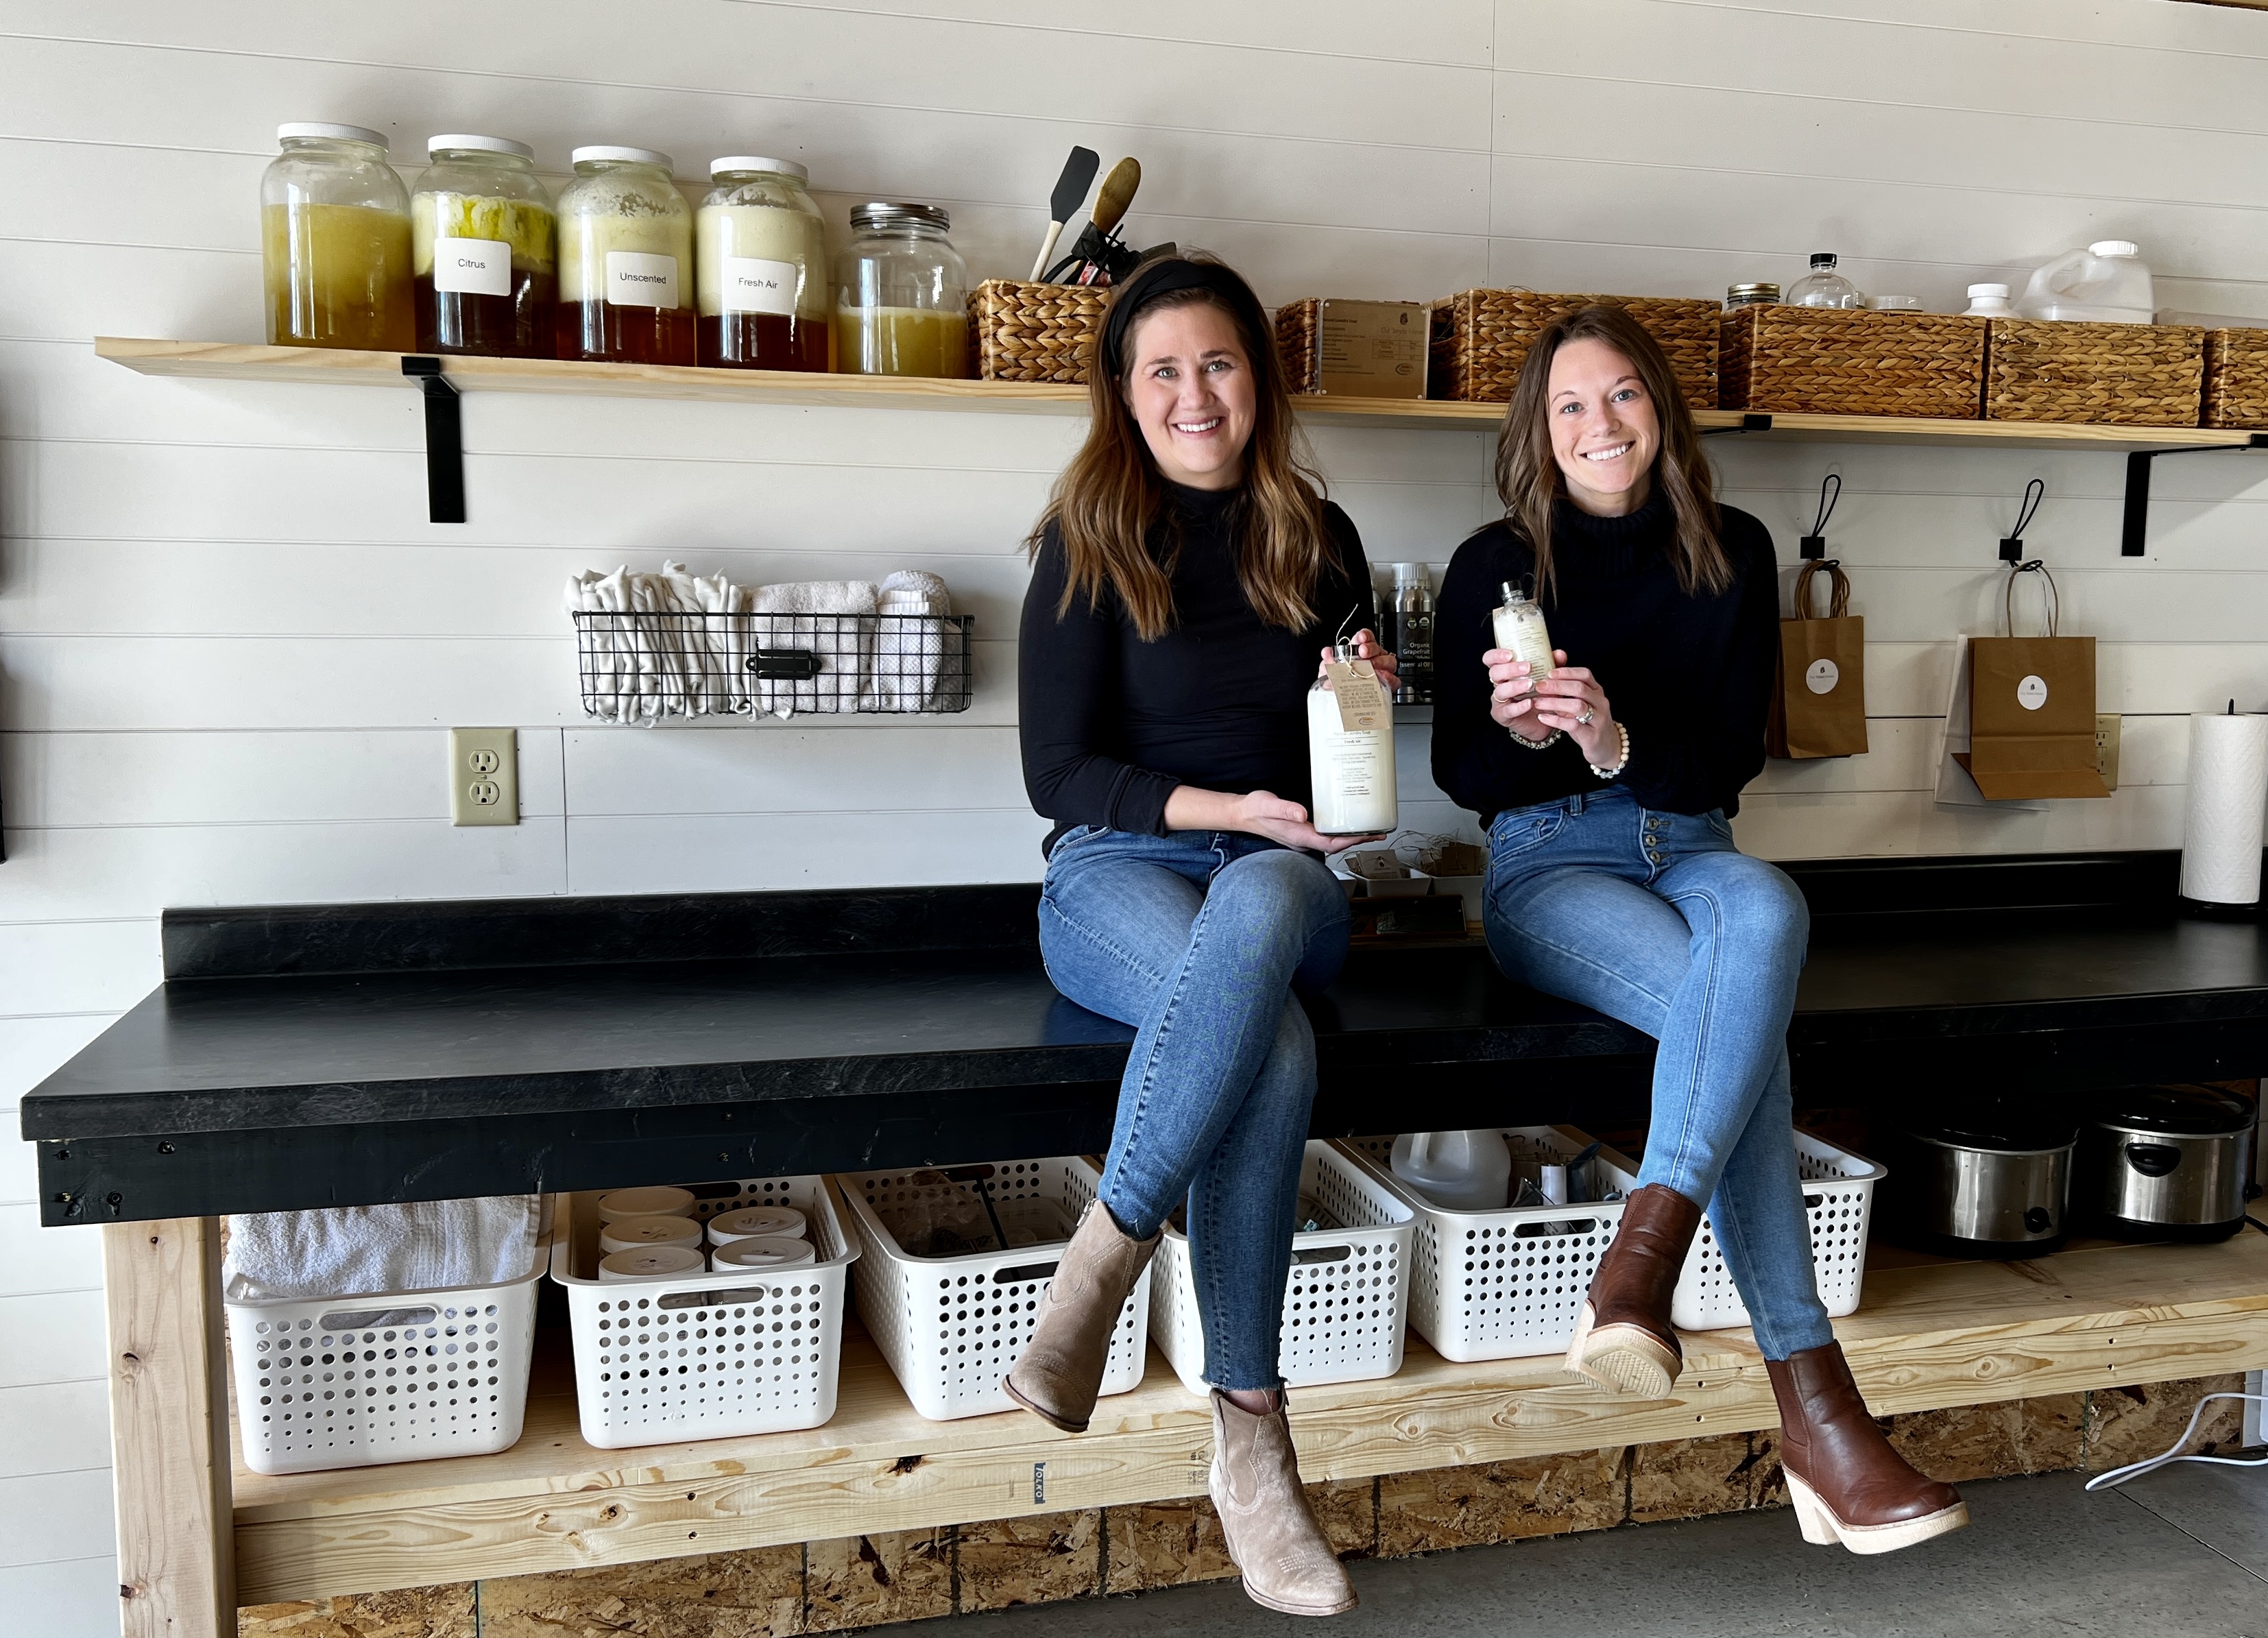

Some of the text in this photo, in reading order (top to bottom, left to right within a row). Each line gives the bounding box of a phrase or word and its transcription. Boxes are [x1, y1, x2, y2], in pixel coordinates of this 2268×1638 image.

[458, 258, 485, 269] Citrus
[620, 272, 666, 285] Unscented
[738, 277, 778, 289] Fresh Air
